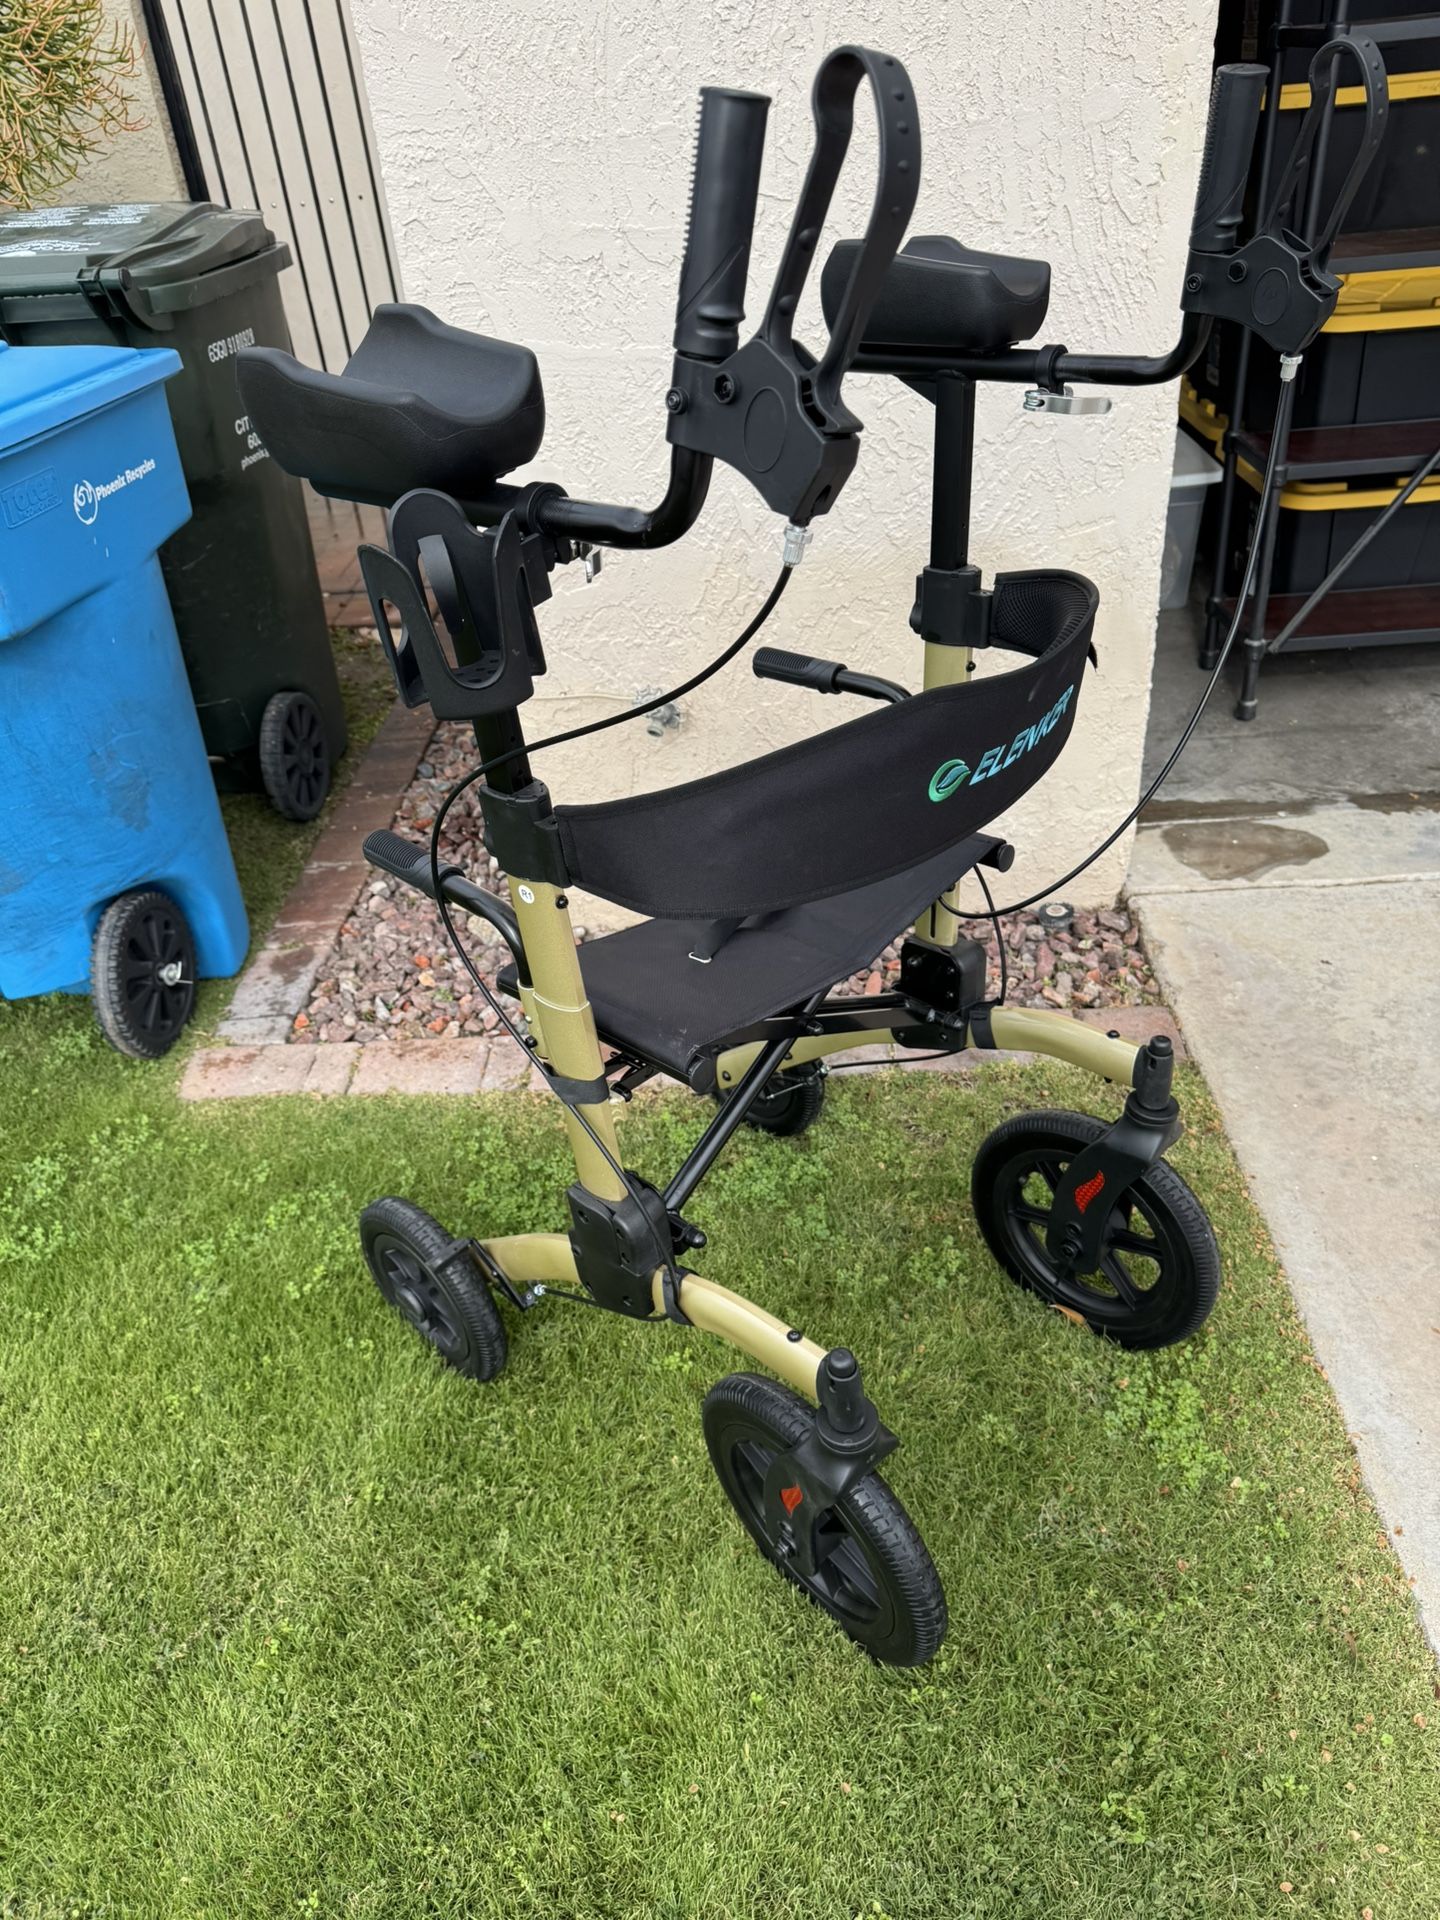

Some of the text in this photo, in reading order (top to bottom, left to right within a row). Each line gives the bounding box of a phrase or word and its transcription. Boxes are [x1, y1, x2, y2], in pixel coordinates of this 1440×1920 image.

[235, 416, 253, 435] CIT
[95, 459, 156, 501] Phoenix Recycles
[969, 684, 1074, 786] ELENKER
[520, 888, 533, 901] R1
